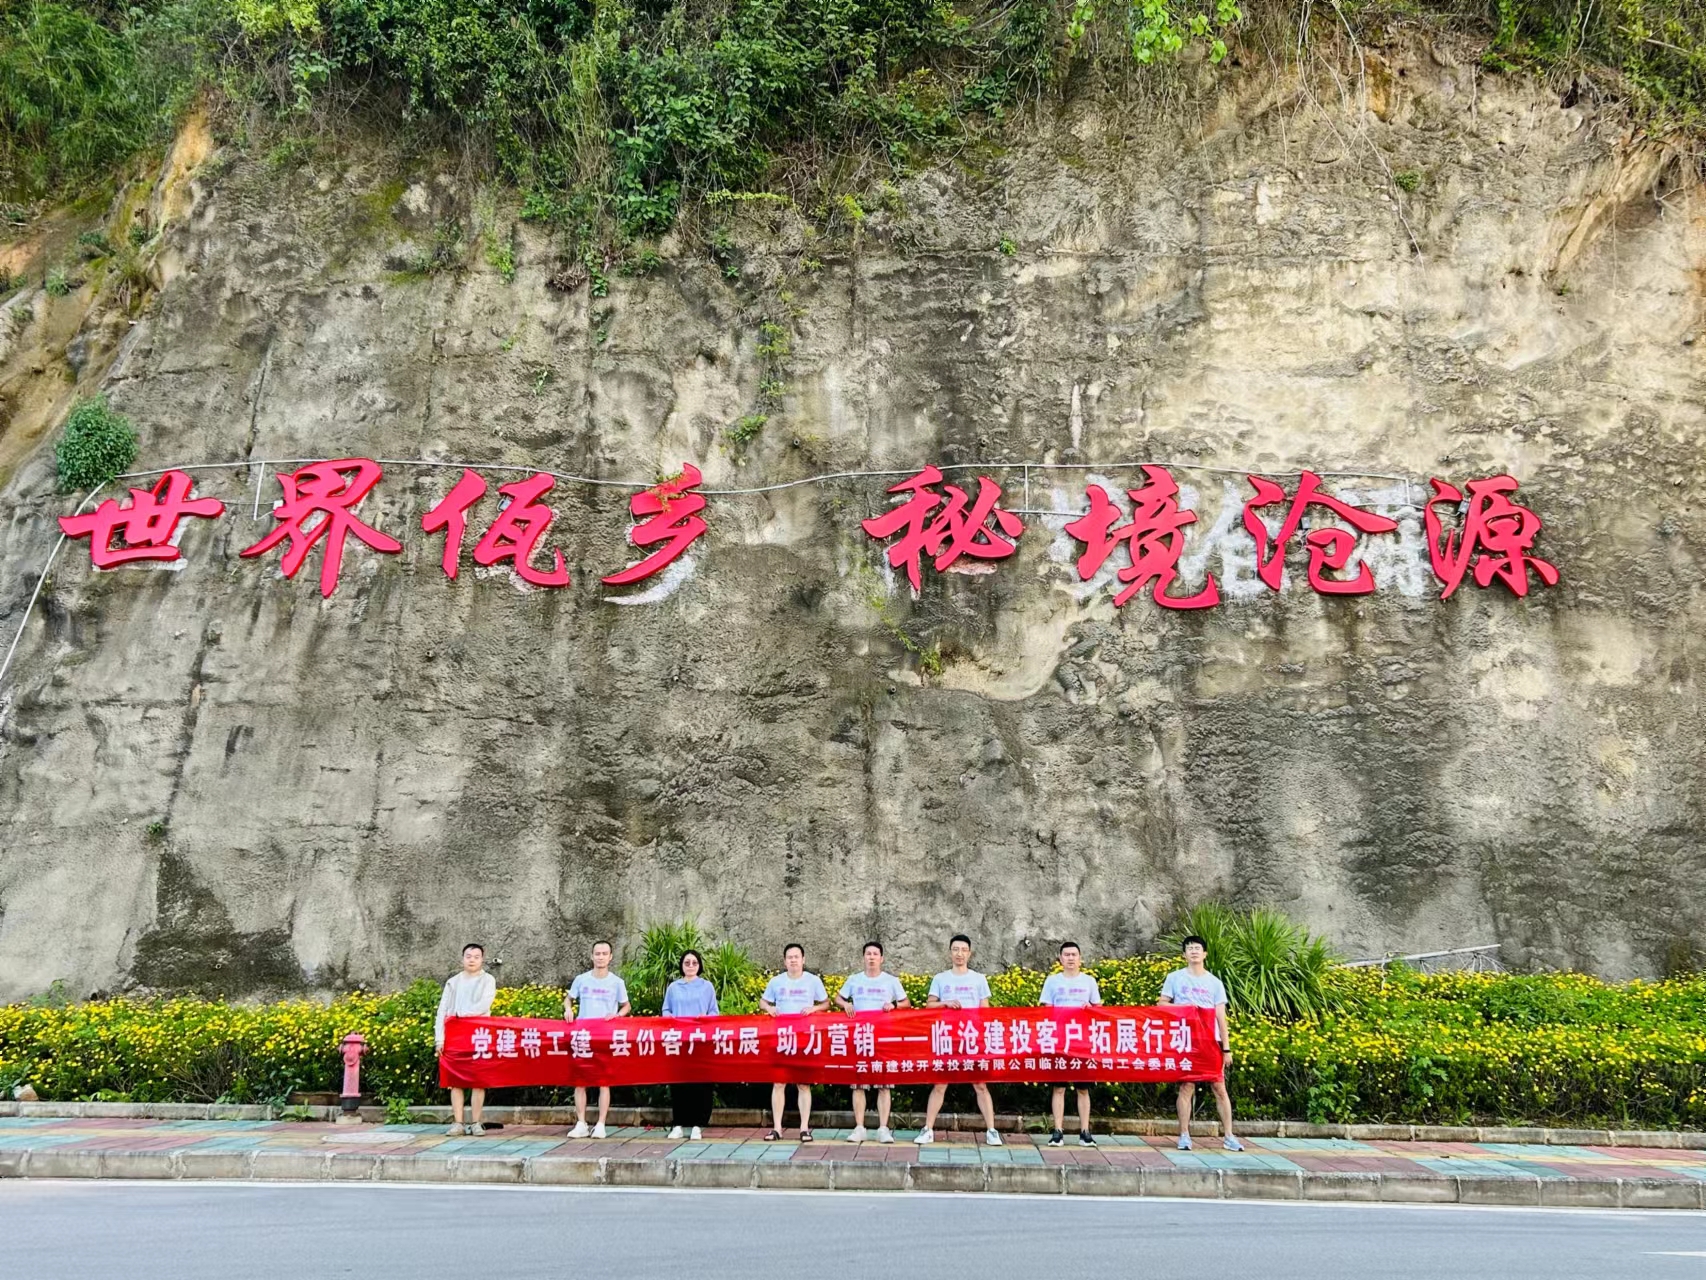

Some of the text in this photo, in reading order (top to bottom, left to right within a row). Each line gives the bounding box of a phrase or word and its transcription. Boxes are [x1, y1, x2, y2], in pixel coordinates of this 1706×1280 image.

[58, 458, 1560, 609] 世界佤乡 秘境沧源
[471, 1018, 1193, 1060] 党建带工建 县份客户拓展 助力营销——临沧建投客户拓展行动
